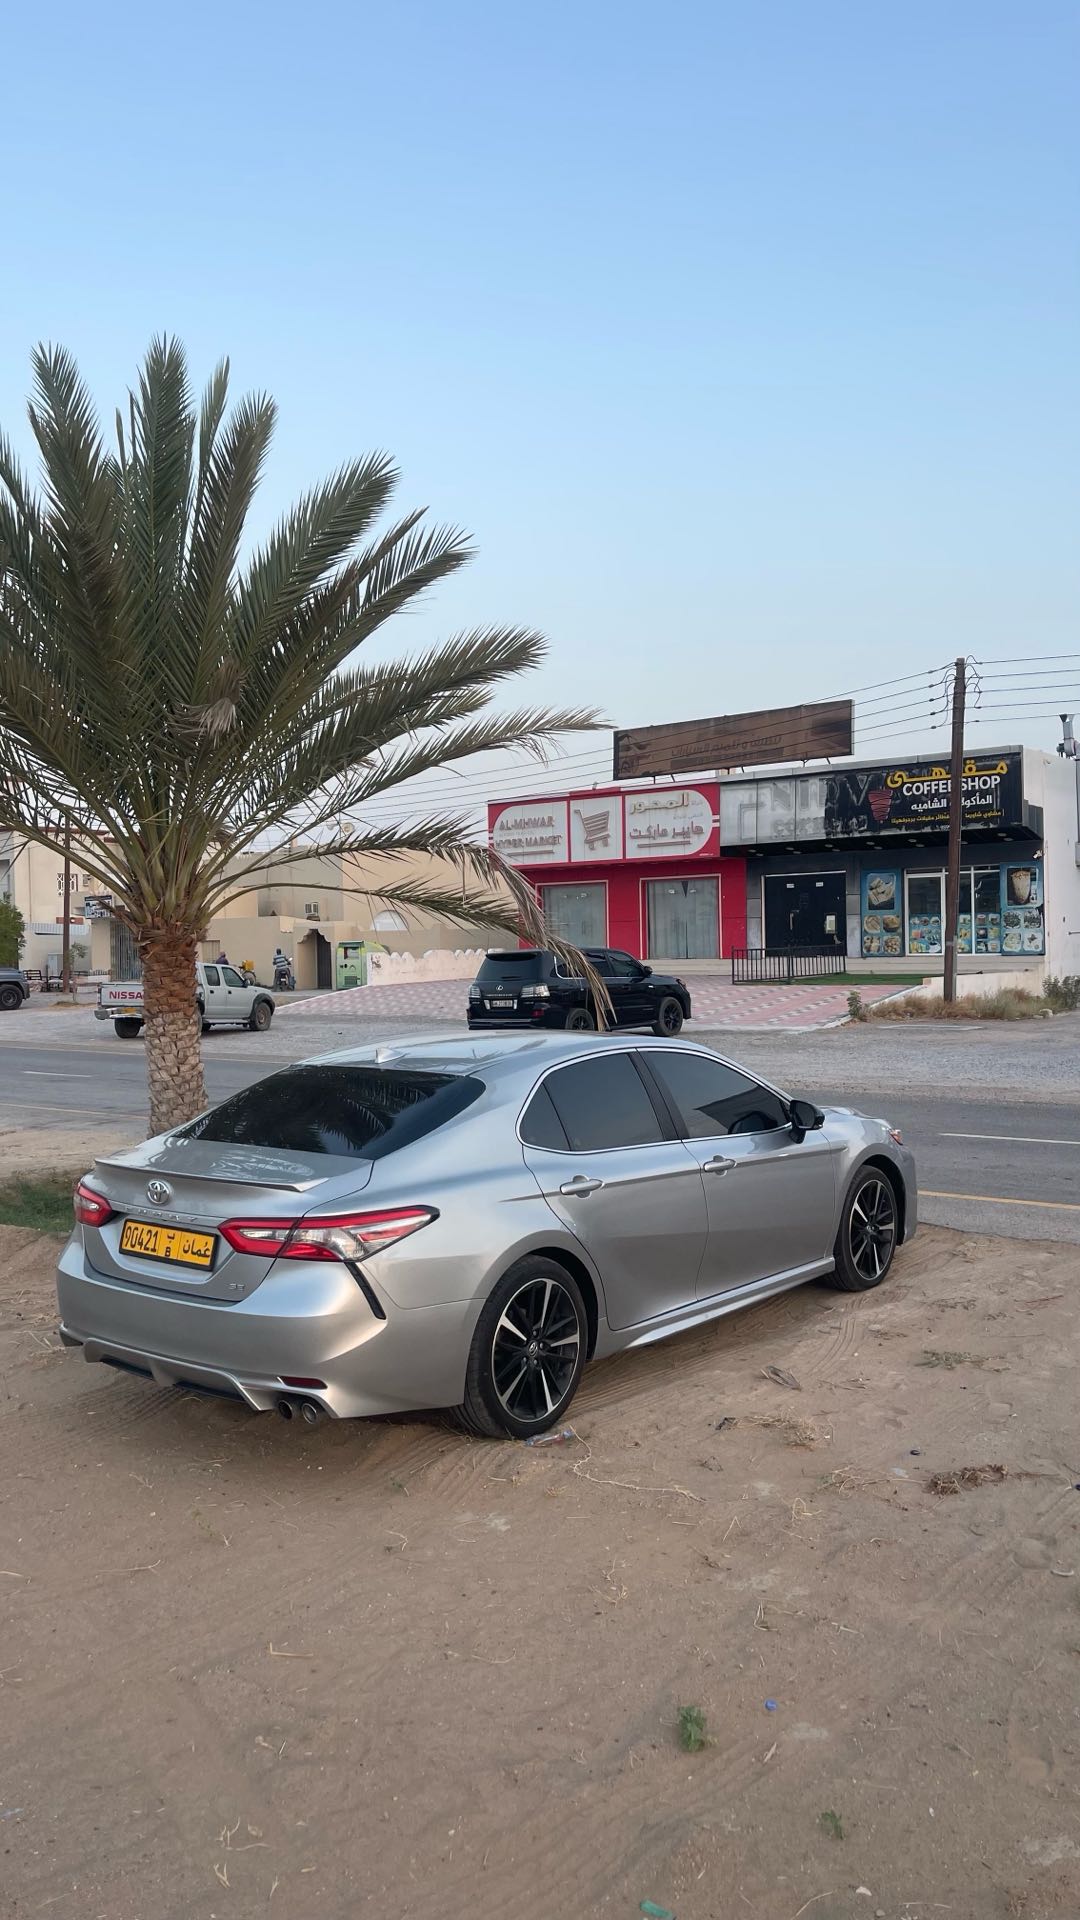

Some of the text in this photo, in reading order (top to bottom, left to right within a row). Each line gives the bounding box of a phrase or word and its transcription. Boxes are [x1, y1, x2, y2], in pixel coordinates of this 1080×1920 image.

[902, 775, 1001, 796] COFFE SHOP
[911, 797, 947, 812] الشاميه
[525, 834, 562, 848] MARKET
[109, 991, 144, 1000] NISSA
[124, 1224, 159, 1253] 90421
[164, 1246, 172, 1257] B
